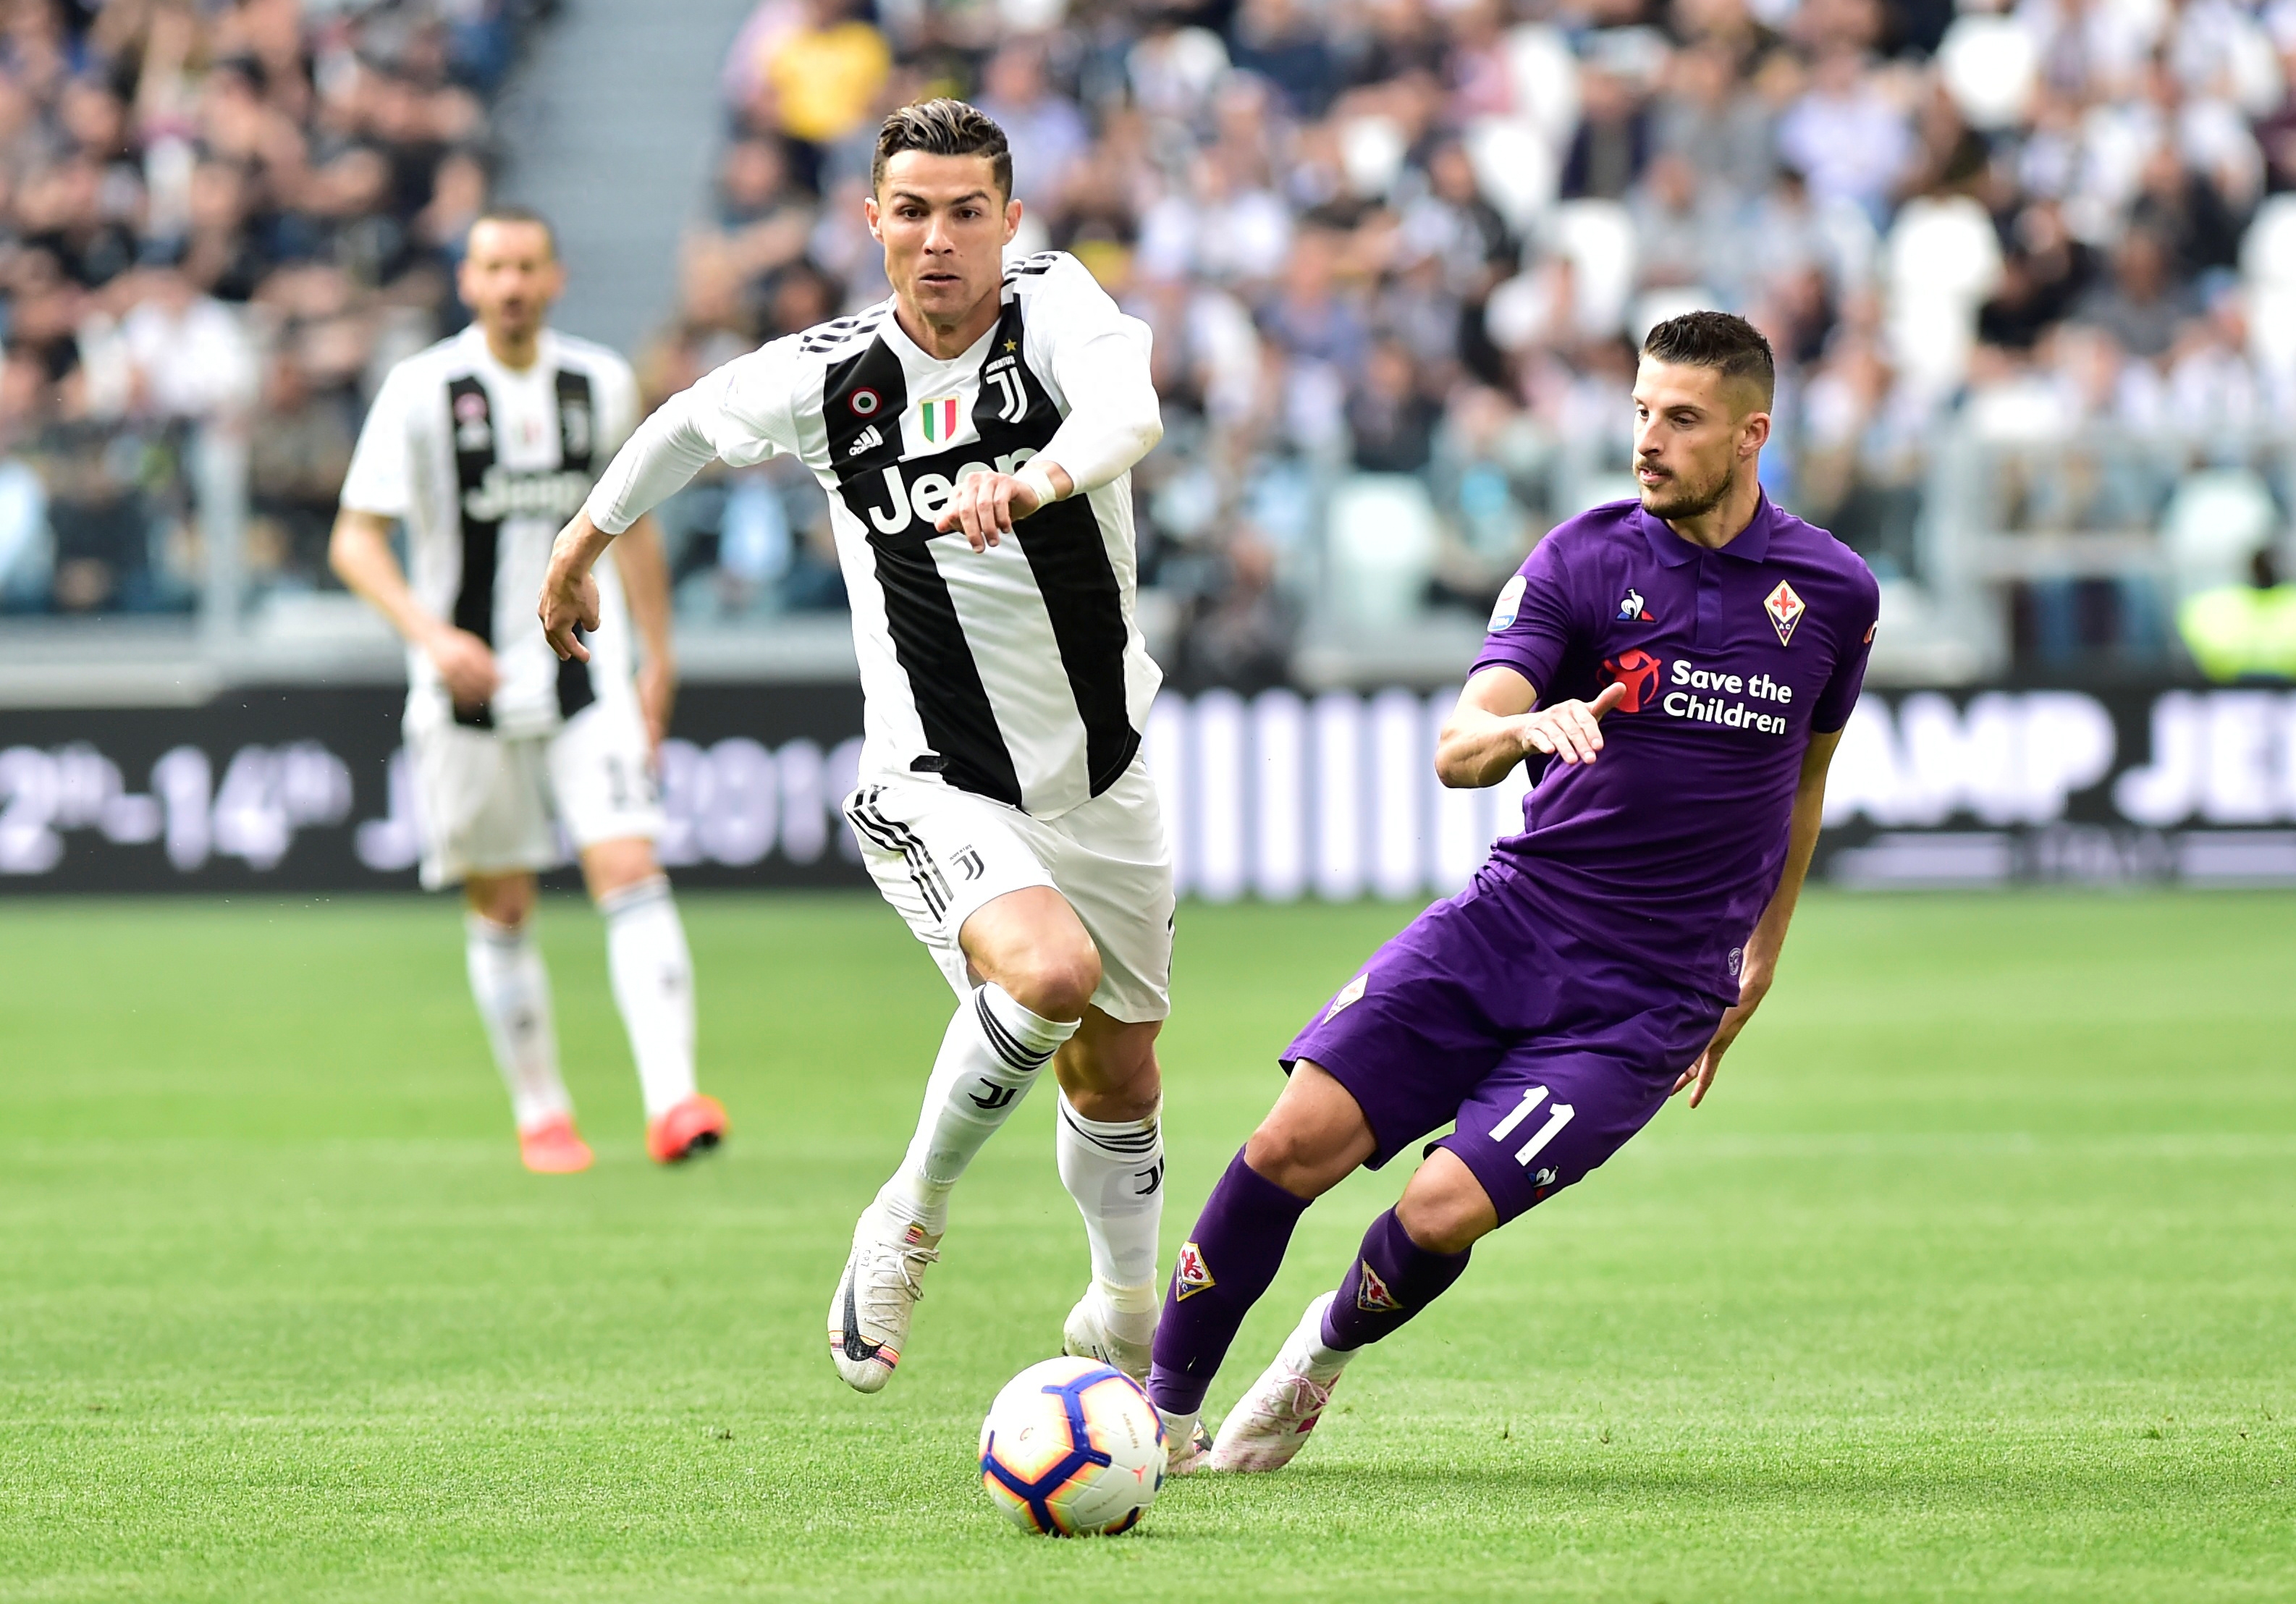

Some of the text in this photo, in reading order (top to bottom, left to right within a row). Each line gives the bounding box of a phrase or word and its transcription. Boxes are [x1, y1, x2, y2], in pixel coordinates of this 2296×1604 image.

[1663, 692, 1786, 735] Children
[1671, 659, 1792, 704] Save the
[1820, 697, 2117, 829] AMP
[1487, 1084, 1576, 1167] 11
